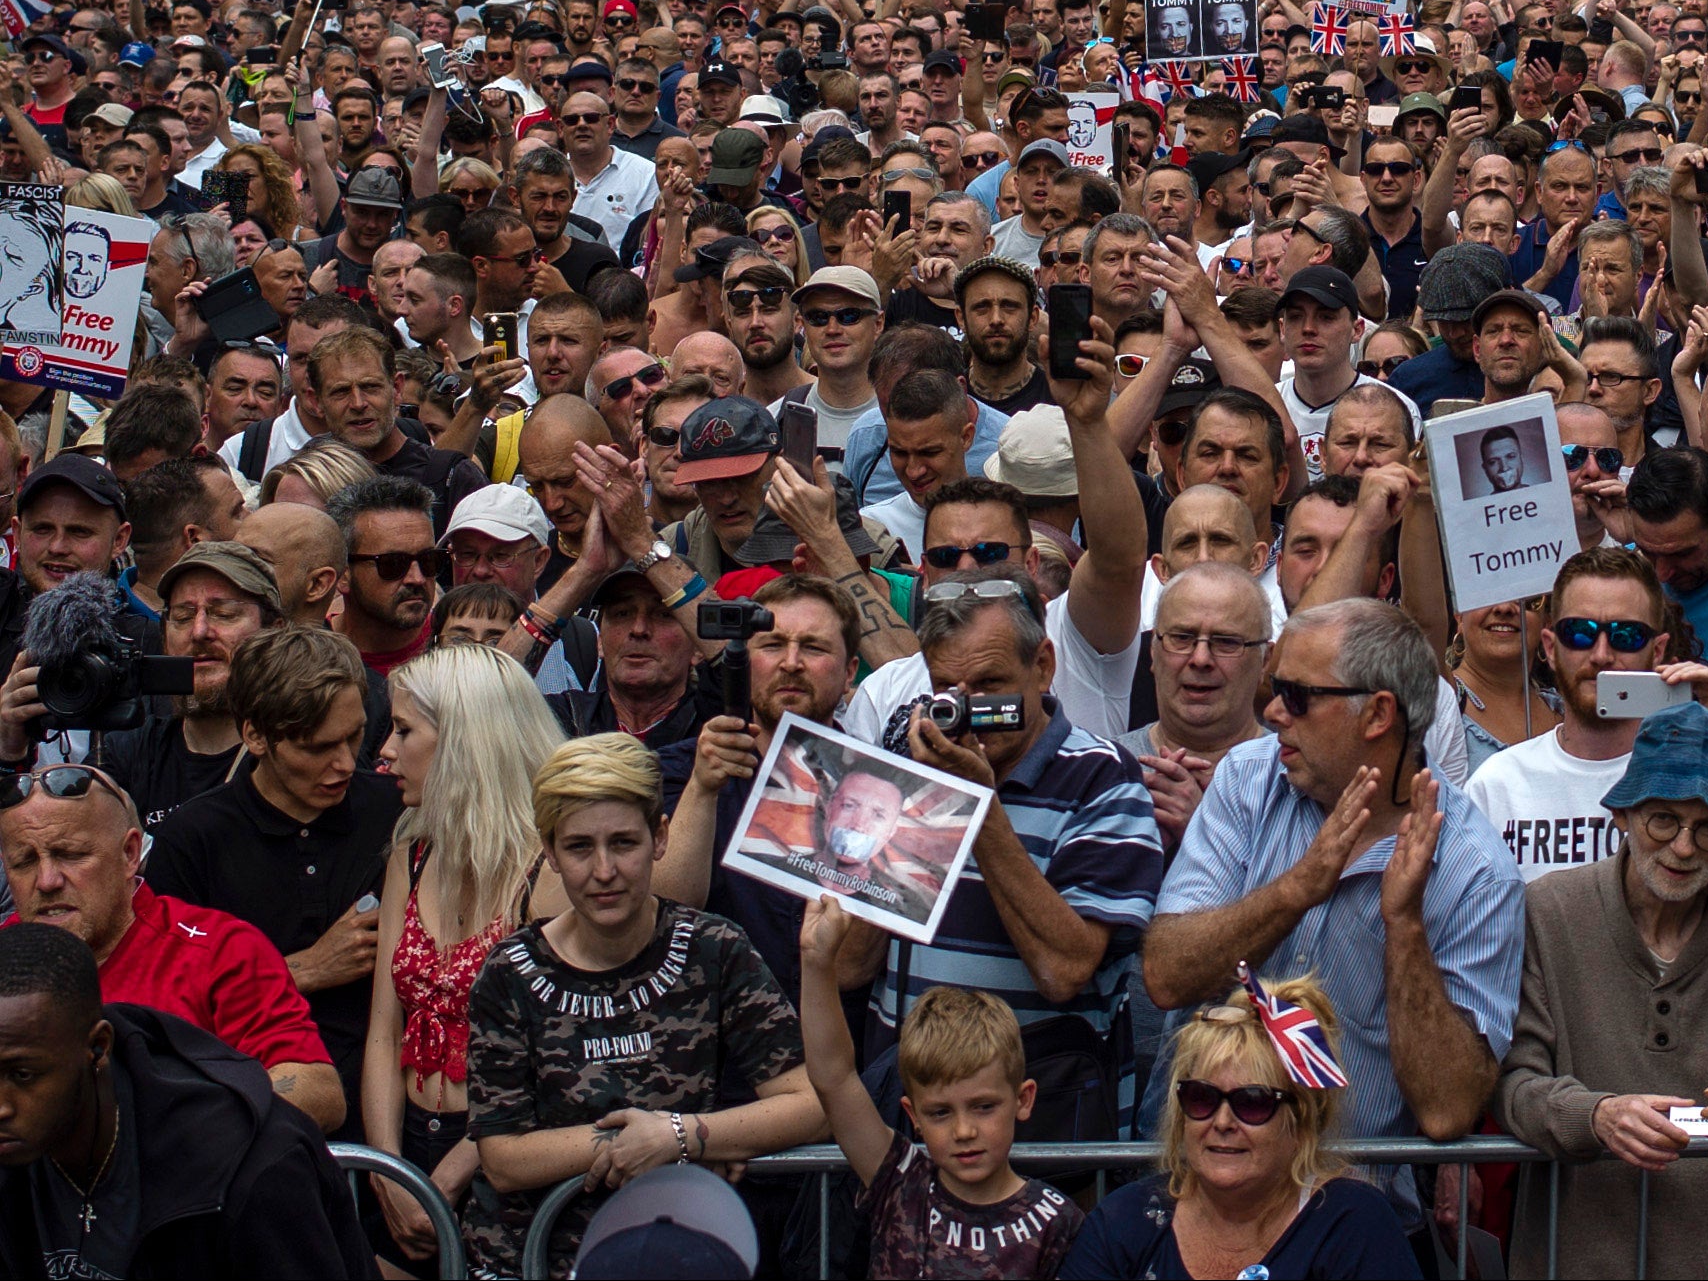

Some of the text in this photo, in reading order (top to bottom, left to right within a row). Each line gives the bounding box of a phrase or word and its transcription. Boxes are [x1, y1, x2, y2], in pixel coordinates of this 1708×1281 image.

[1338, 0, 1389, 14] #FREETOMMY
[8, 185, 62, 200] FASCIST
[63, 303, 114, 331] Free
[0, 329, 61, 346] FAWSTIN
[61, 331, 120, 362] mmy
[1484, 501, 1538, 527] Free
[1469, 540, 1563, 574] Tommy
[1503, 817, 1621, 865] #FREETO
[786, 851, 897, 904] #FreeTommyRobinson
[504, 920, 695, 1018] NOW OR NEVER NO REGRETS
[583, 1031, 652, 1059] PRO-FOUND
[946, 1188, 1066, 1251] NOTHING
